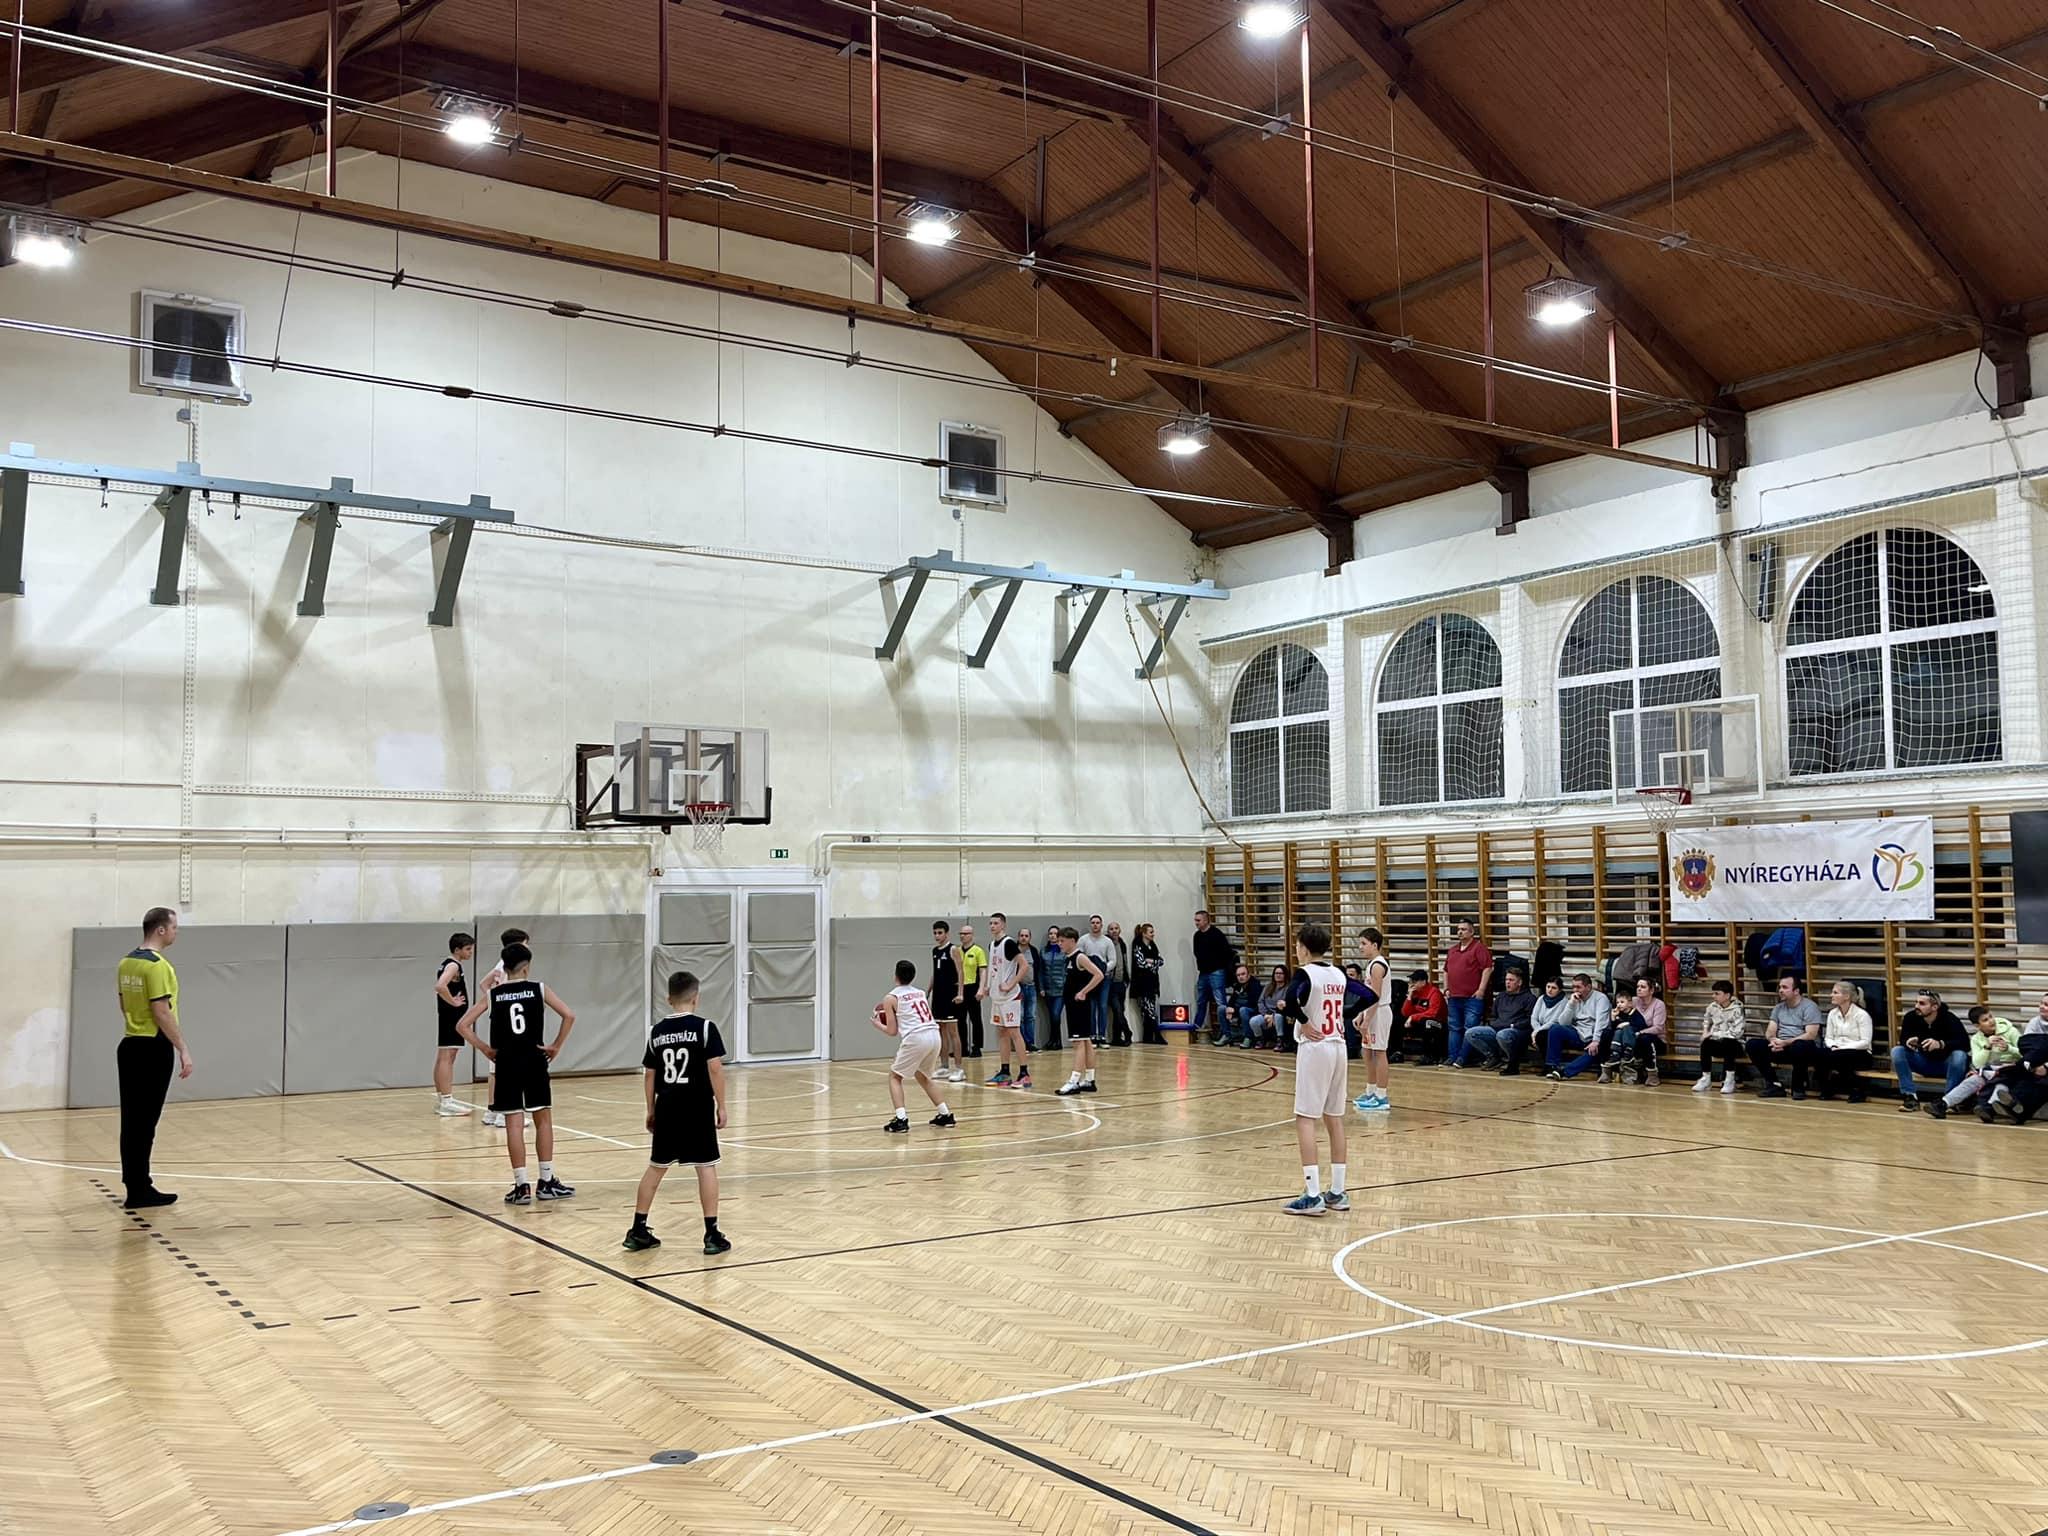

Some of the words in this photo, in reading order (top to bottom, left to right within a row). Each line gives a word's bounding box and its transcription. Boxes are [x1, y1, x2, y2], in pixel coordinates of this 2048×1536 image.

[1725, 859, 1862, 884] NYÍREGYHÁZA
[510, 1002, 526, 1034] 6
[1175, 1006, 1186, 1021] 9
[1321, 999, 1344, 1037] 35
[653, 1029, 698, 1048] NYÍREGYHÁZA
[662, 1047, 689, 1084] 82
